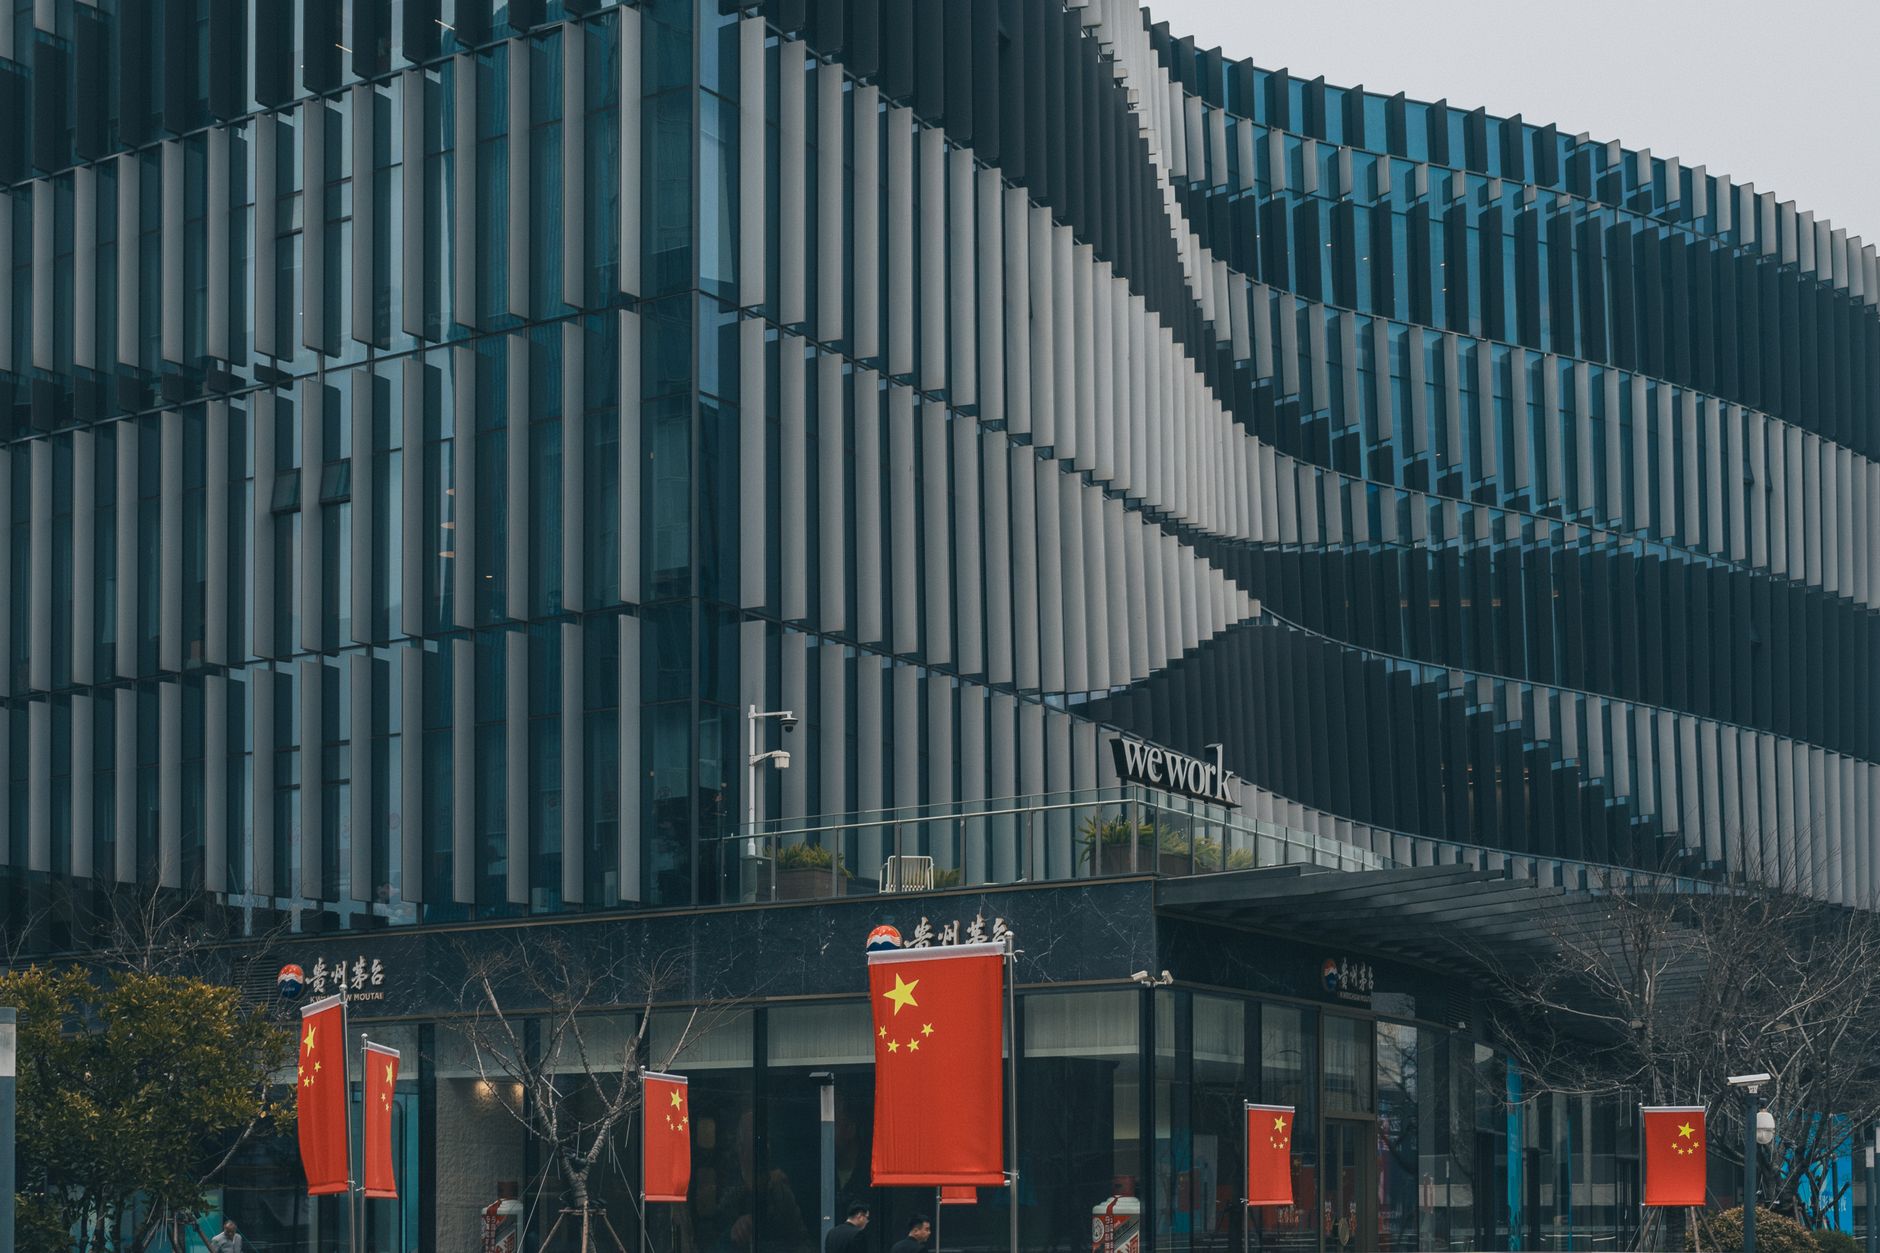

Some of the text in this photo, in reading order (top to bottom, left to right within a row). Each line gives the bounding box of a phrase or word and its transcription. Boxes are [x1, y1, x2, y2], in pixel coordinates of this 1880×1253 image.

[305, 955, 385, 993] 贵州茅台
[354, 992, 384, 1001] MOUTAI
